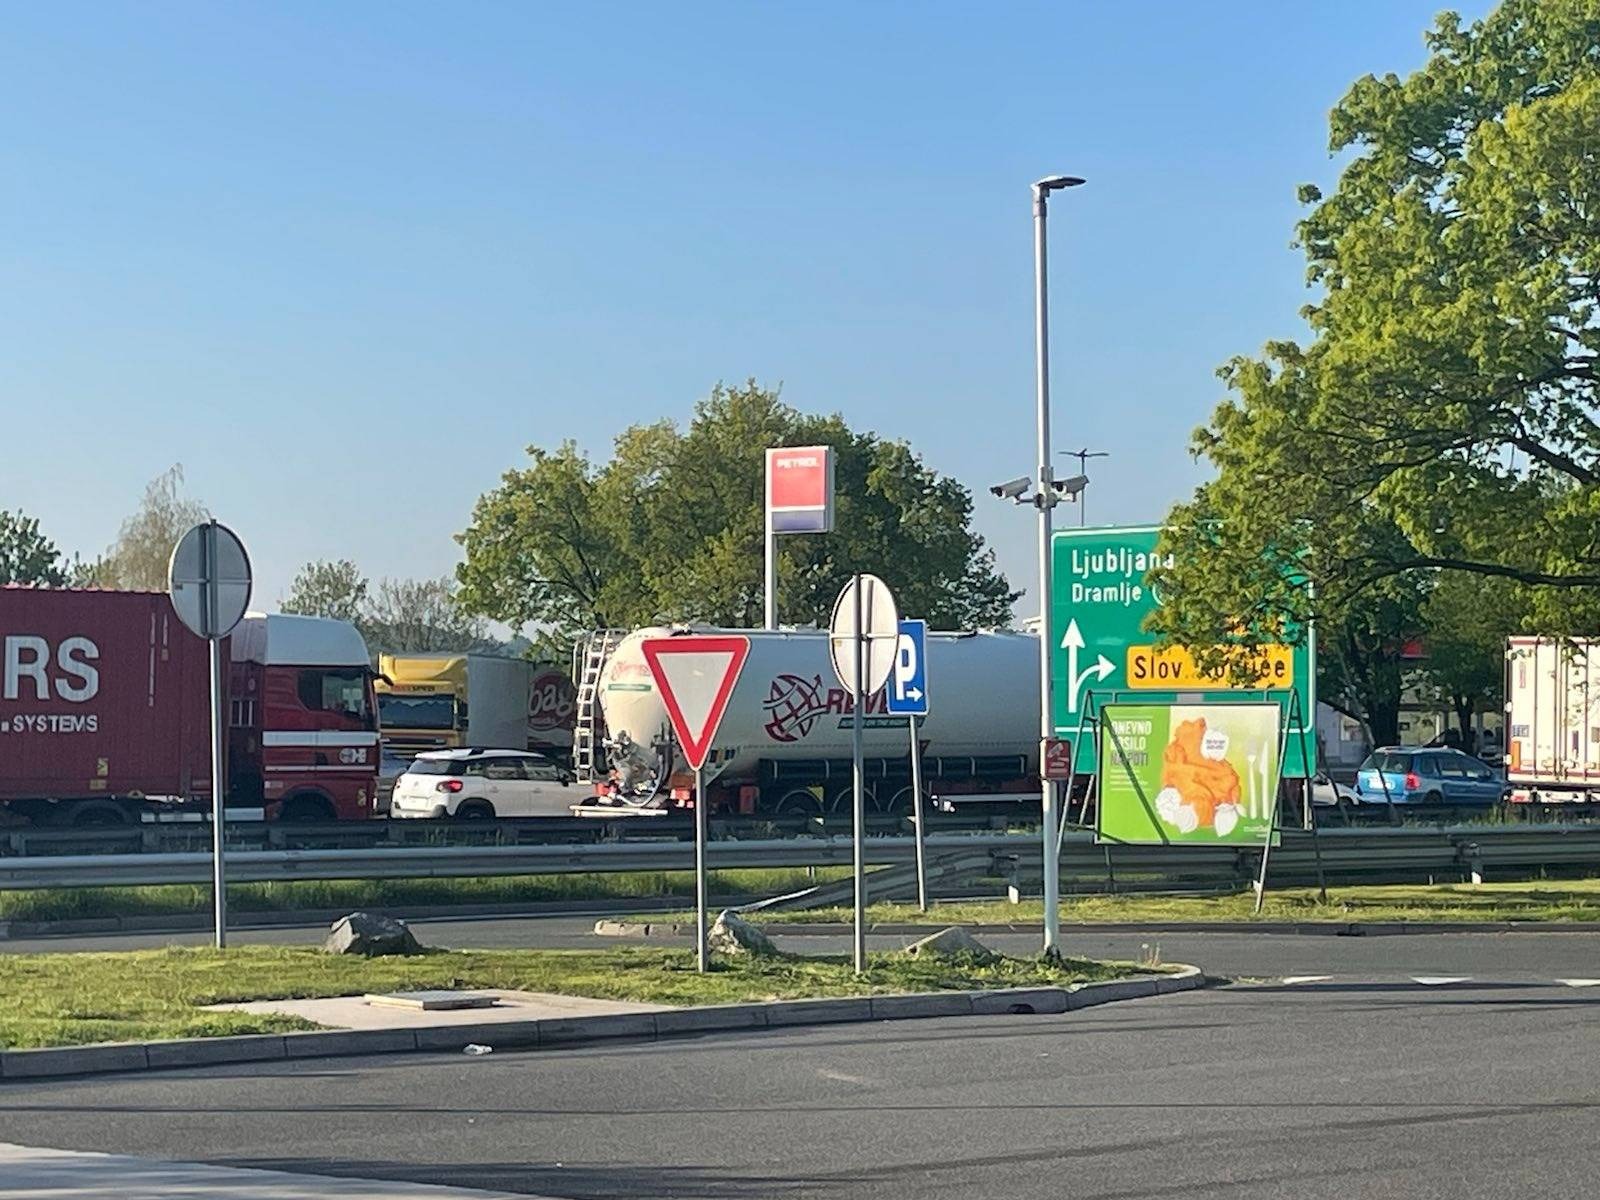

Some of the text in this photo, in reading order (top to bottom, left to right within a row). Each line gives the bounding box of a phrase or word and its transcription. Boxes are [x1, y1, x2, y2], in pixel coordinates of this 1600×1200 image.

[1072, 547, 1175, 579] Ljubljana
[1072, 582, 1142, 607] Dramlje
[894, 634, 917, 700] P
[13, 714, 98, 732] SYSTEMS
